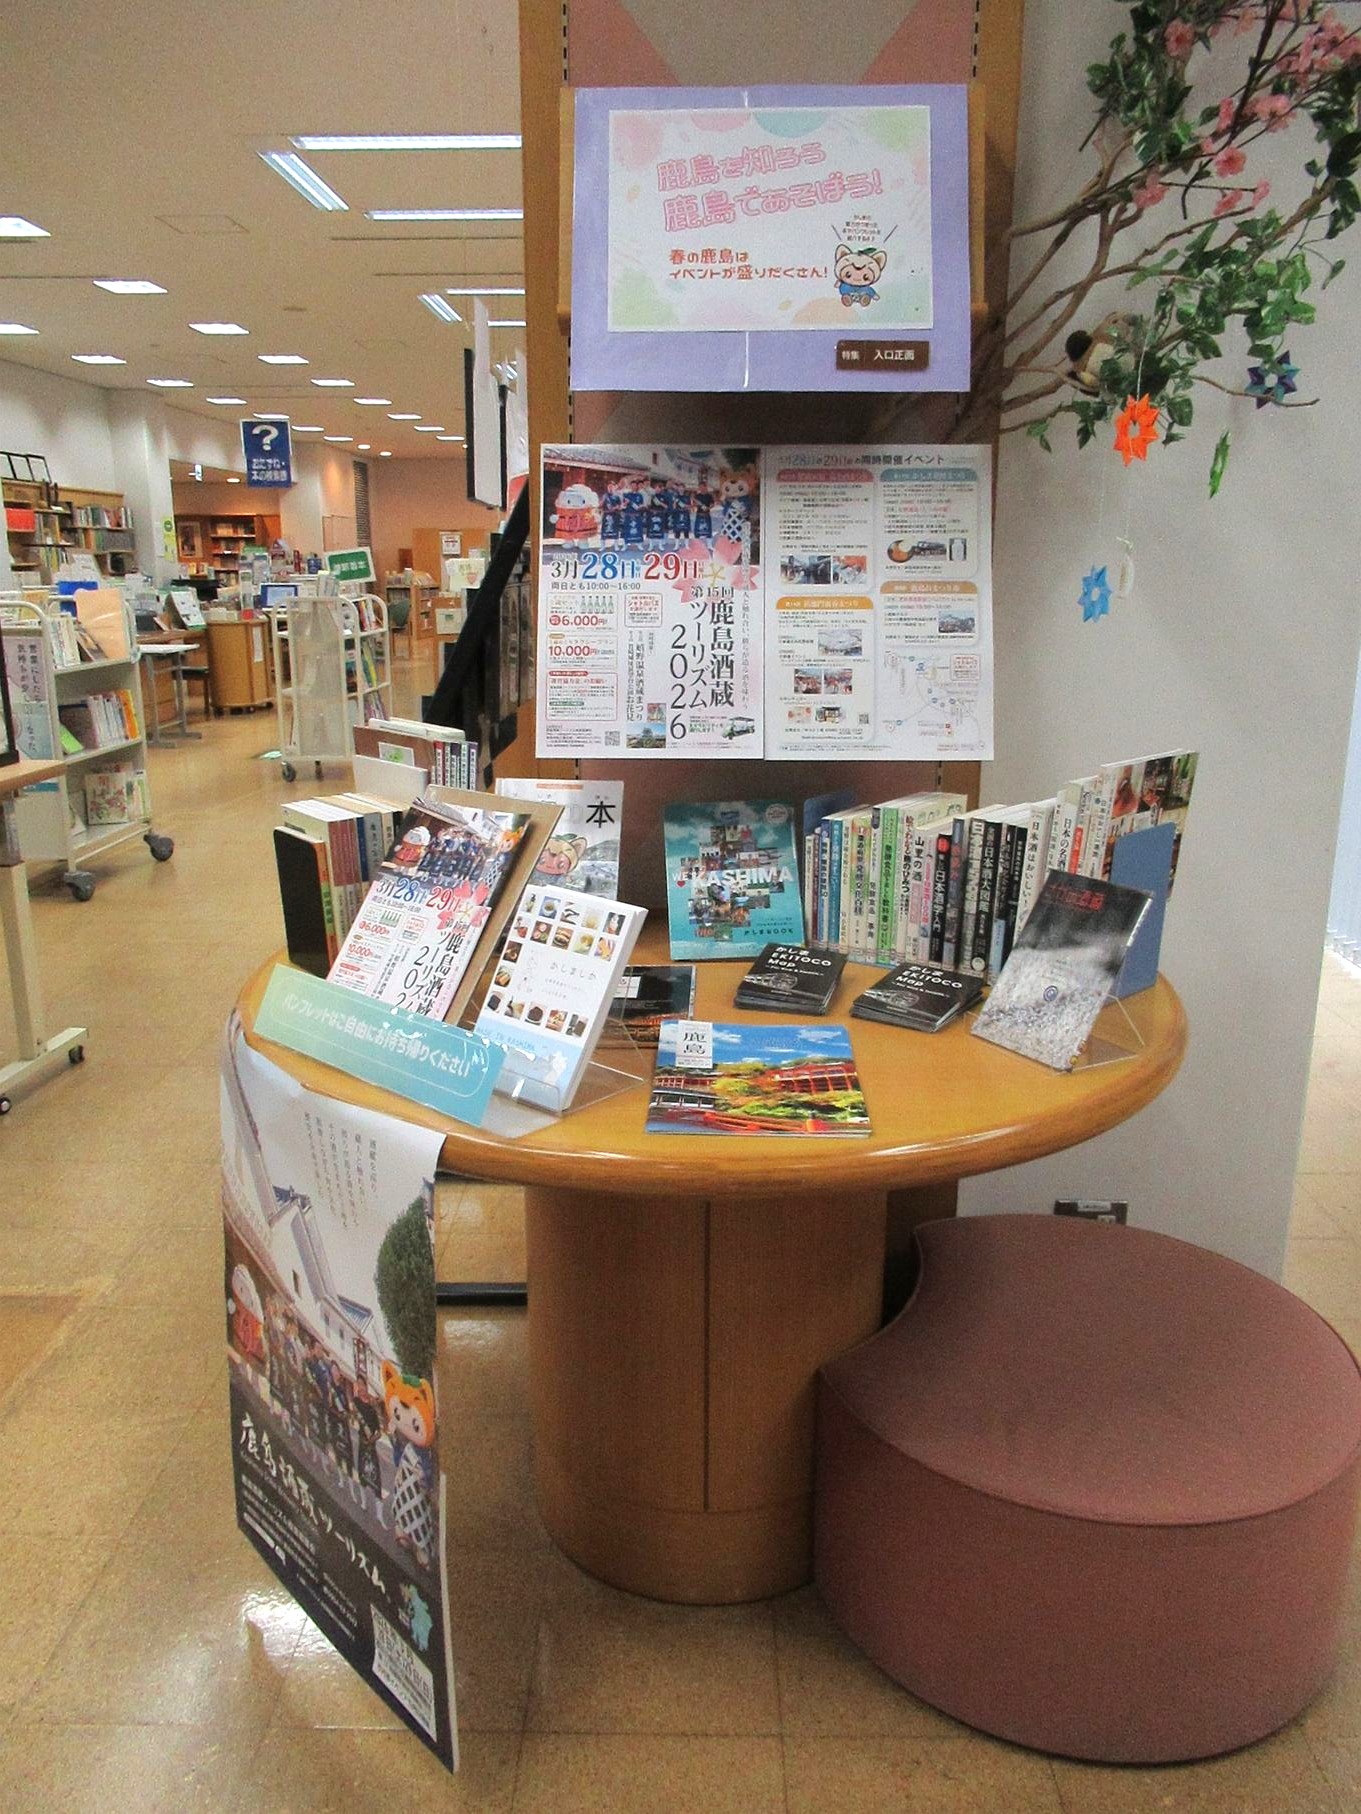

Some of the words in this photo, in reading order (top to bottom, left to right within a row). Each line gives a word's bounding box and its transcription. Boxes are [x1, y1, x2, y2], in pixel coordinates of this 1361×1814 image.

[657, 142, 827, 191] 鹿島を知ろう
[668, 248, 750, 266] 春の鹿島は
[669, 264, 828, 281] イベントが盛りだくさん!
[873, 350, 915, 361] 入口正面
[689, 602, 708, 709] ツーリズム
[709, 599, 735, 708] 鹿島酒蔵
[670, 624, 688, 740] 2026
[585, 800, 616, 829] 本
[692, 866, 794, 887] KASHIMA
[771, 953, 832, 967] EKITOCO
[775, 946, 810, 956] かしま
[768, 958, 796, 968] Map
[909, 966, 944, 977] かしま
[895, 976, 924, 987] Map
[902, 970, 962, 988] EKITOCO
